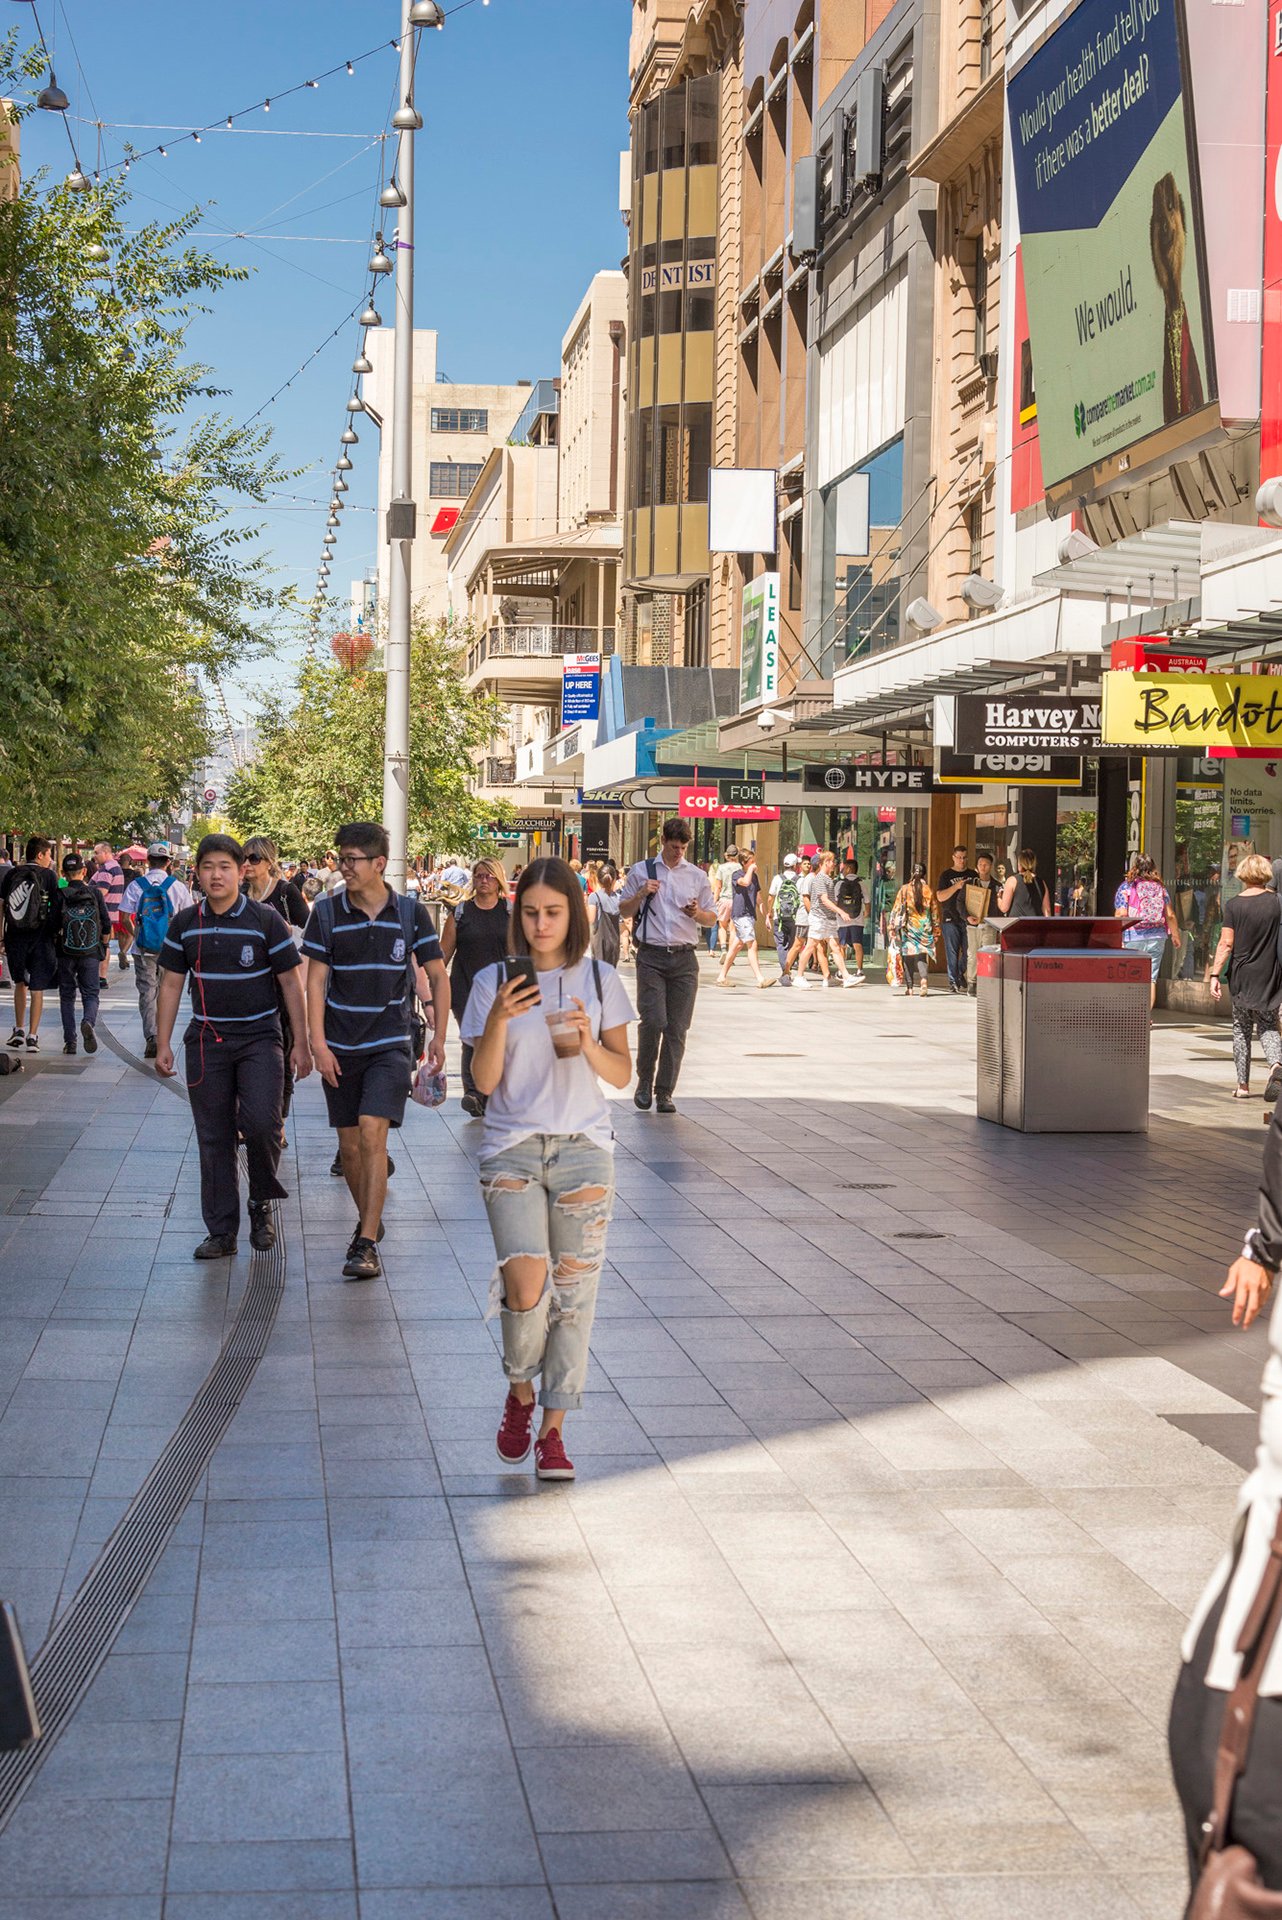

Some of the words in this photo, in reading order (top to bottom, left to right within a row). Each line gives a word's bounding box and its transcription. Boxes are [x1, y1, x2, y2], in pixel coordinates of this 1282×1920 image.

[1019, 91, 1047, 145] Would
[1047, 80, 1066, 132] your
[1066, 42, 1096, 99] health
[1096, 15, 1120, 70] fund
[1120, 0, 1139, 45] tell
[1139, 0, 1159, 42] you
[1034, 152, 1043, 190] if
[1043, 142, 1066, 183] there
[1065, 125, 1084, 163] was
[1085, 118, 1092, 144] a
[1091, 89, 1121, 139] better
[1123, 53, 1149, 110] deal?
[643, 264, 714, 289] DENTIST
[1074, 301, 1096, 346] We
[1096, 265, 1137, 333] would.
[765, 584, 776, 690] LEASE
[565, 681, 574, 689] UP
[575, 681, 593, 689] HERE
[985, 703, 1078, 733] Harvey
[985, 735, 1080, 747] COMPUTERS
[855, 771, 922, 787] HYPE
[1230, 788, 1242, 796] No
[1243, 788, 1263, 796] data
[1230, 797, 1255, 805] limits.
[1230, 806, 1241, 814] No
[1243, 806, 1276, 815] worries.
[9, 881, 30, 910] NIKE
[1033, 961, 1064, 969] Waste
